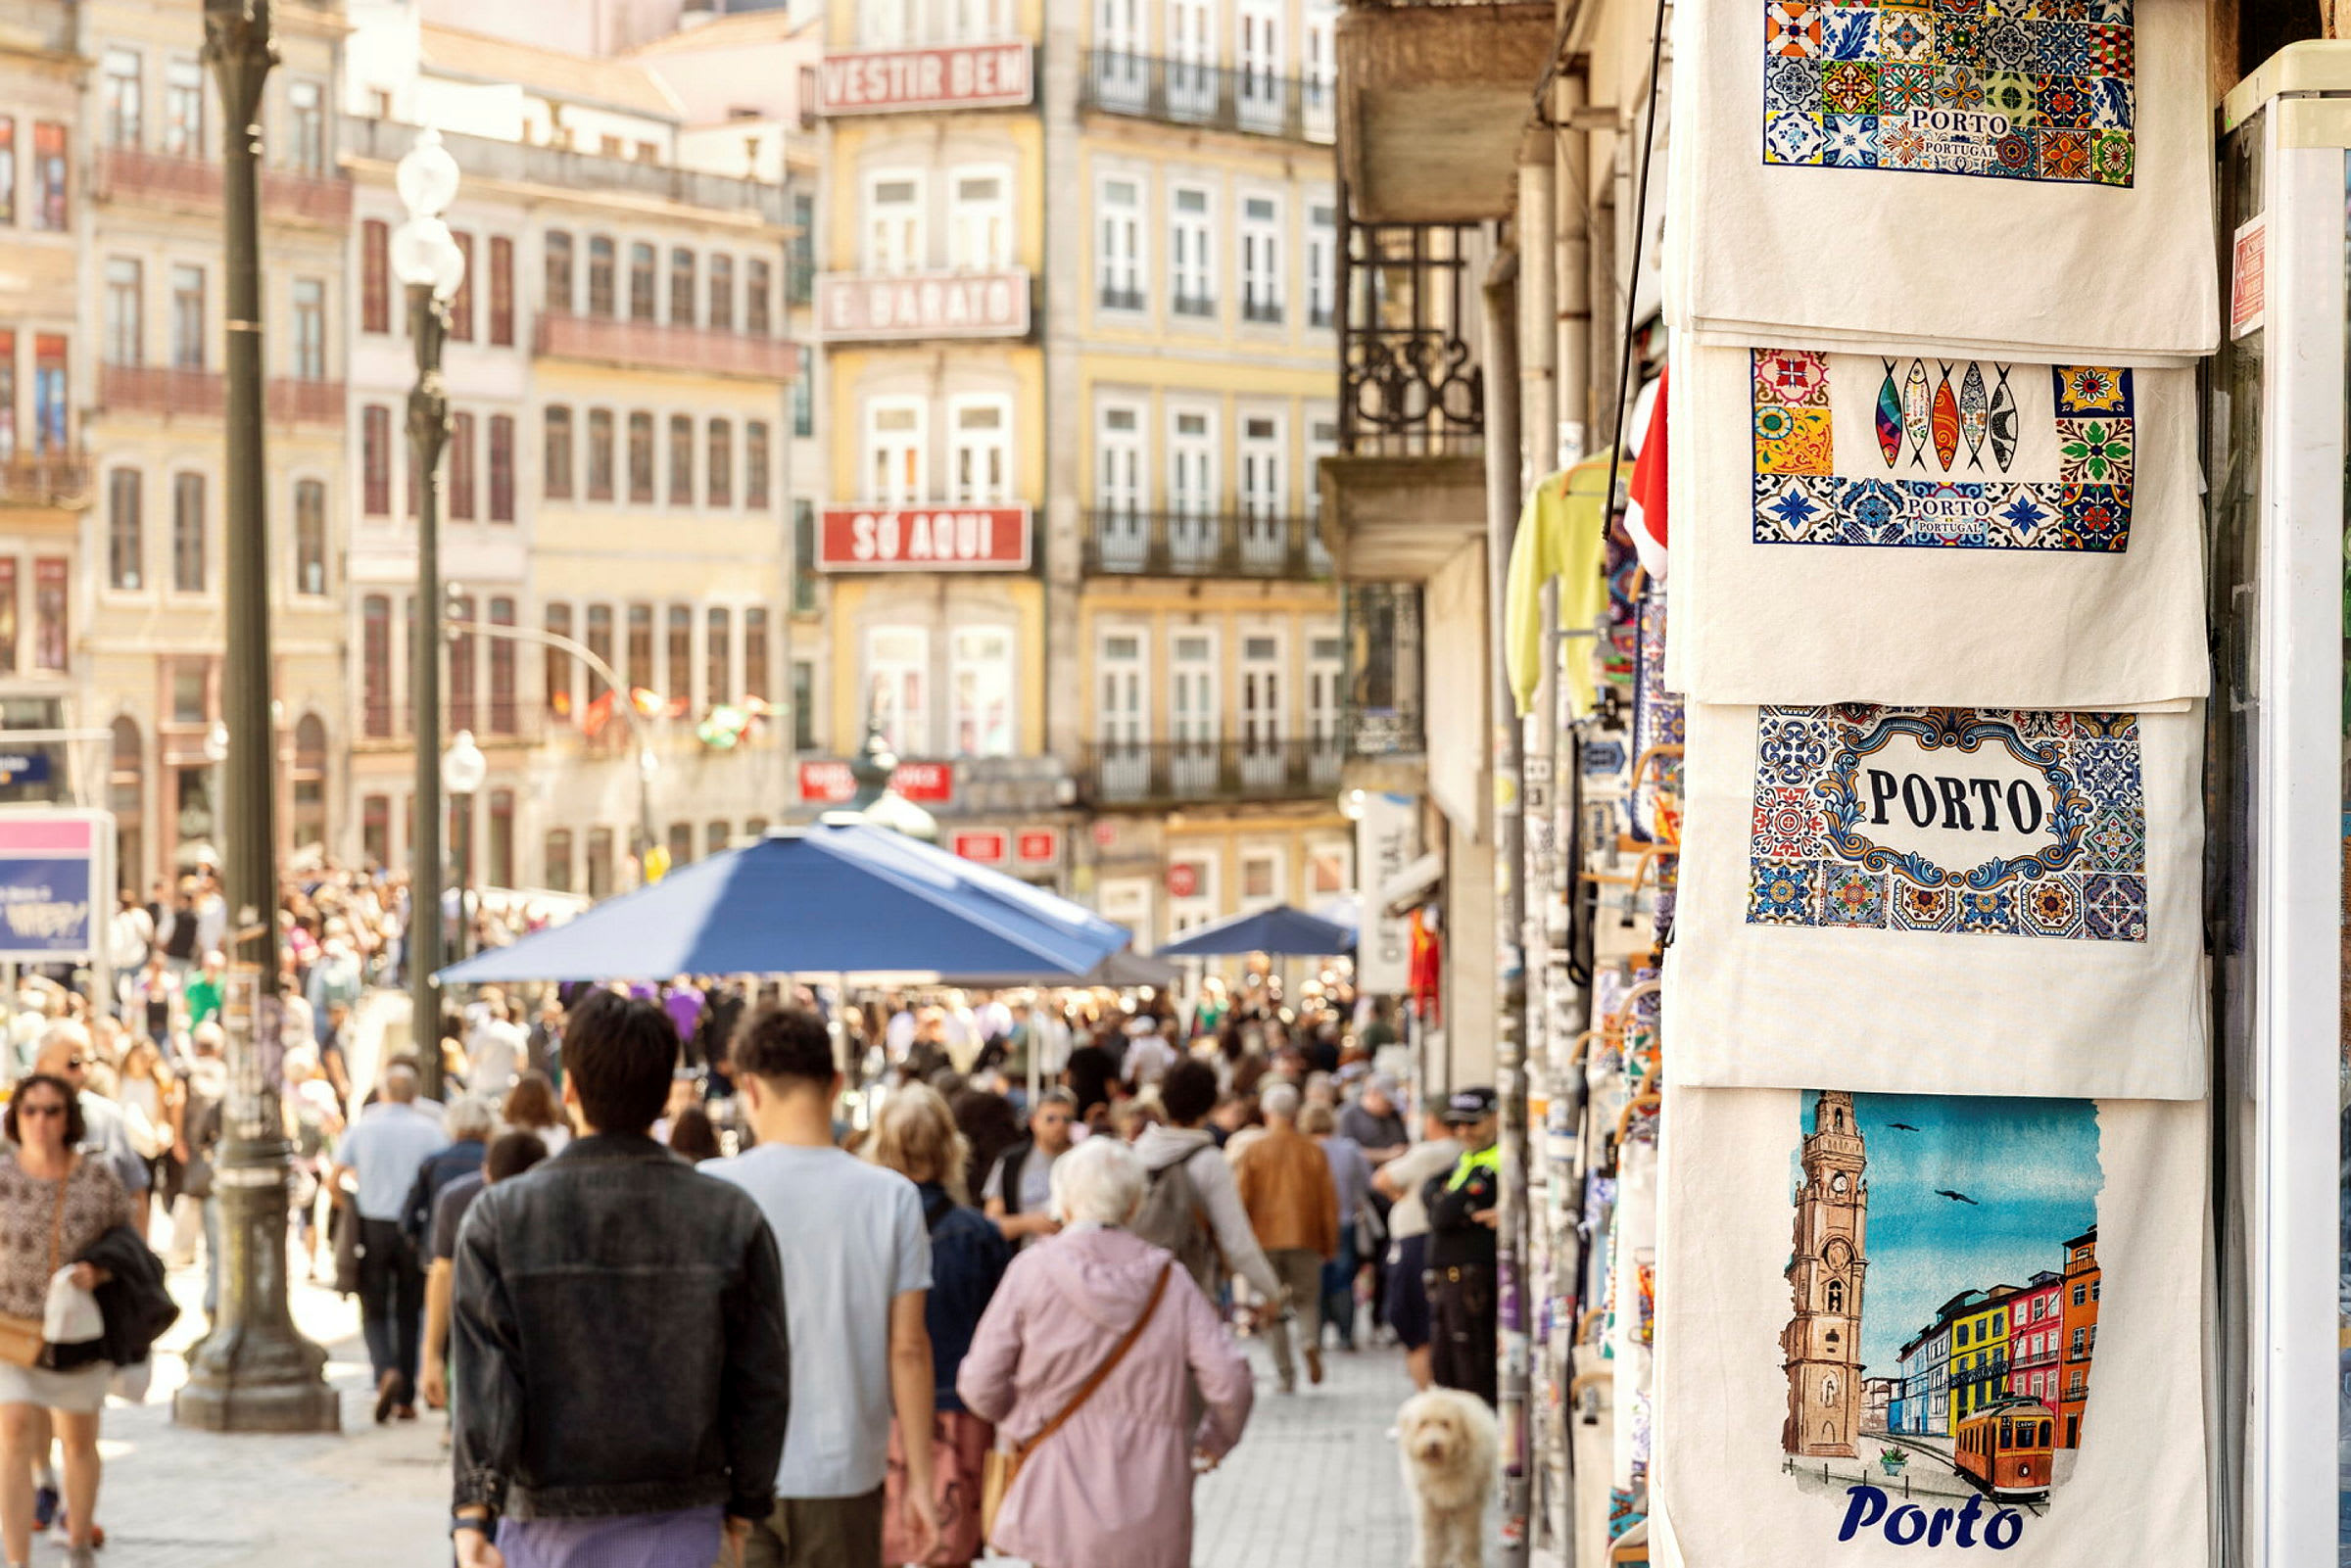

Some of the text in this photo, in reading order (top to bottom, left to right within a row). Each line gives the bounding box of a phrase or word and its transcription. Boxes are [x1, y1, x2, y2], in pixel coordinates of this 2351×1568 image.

[825, 49, 1023, 104] VESTIR BEM
[1912, 110, 2007, 134] PORTO
[1925, 141, 1996, 158] PORTUGAL
[869, 278, 1011, 328] BARATO
[1908, 499, 1990, 516] PORTO
[1919, 522, 1981, 533] PORTUGAL
[851, 508, 993, 561] SÓ AQUI
[1866, 768, 2043, 835] PORTO
[1837, 1485, 2024, 1550] Porto
